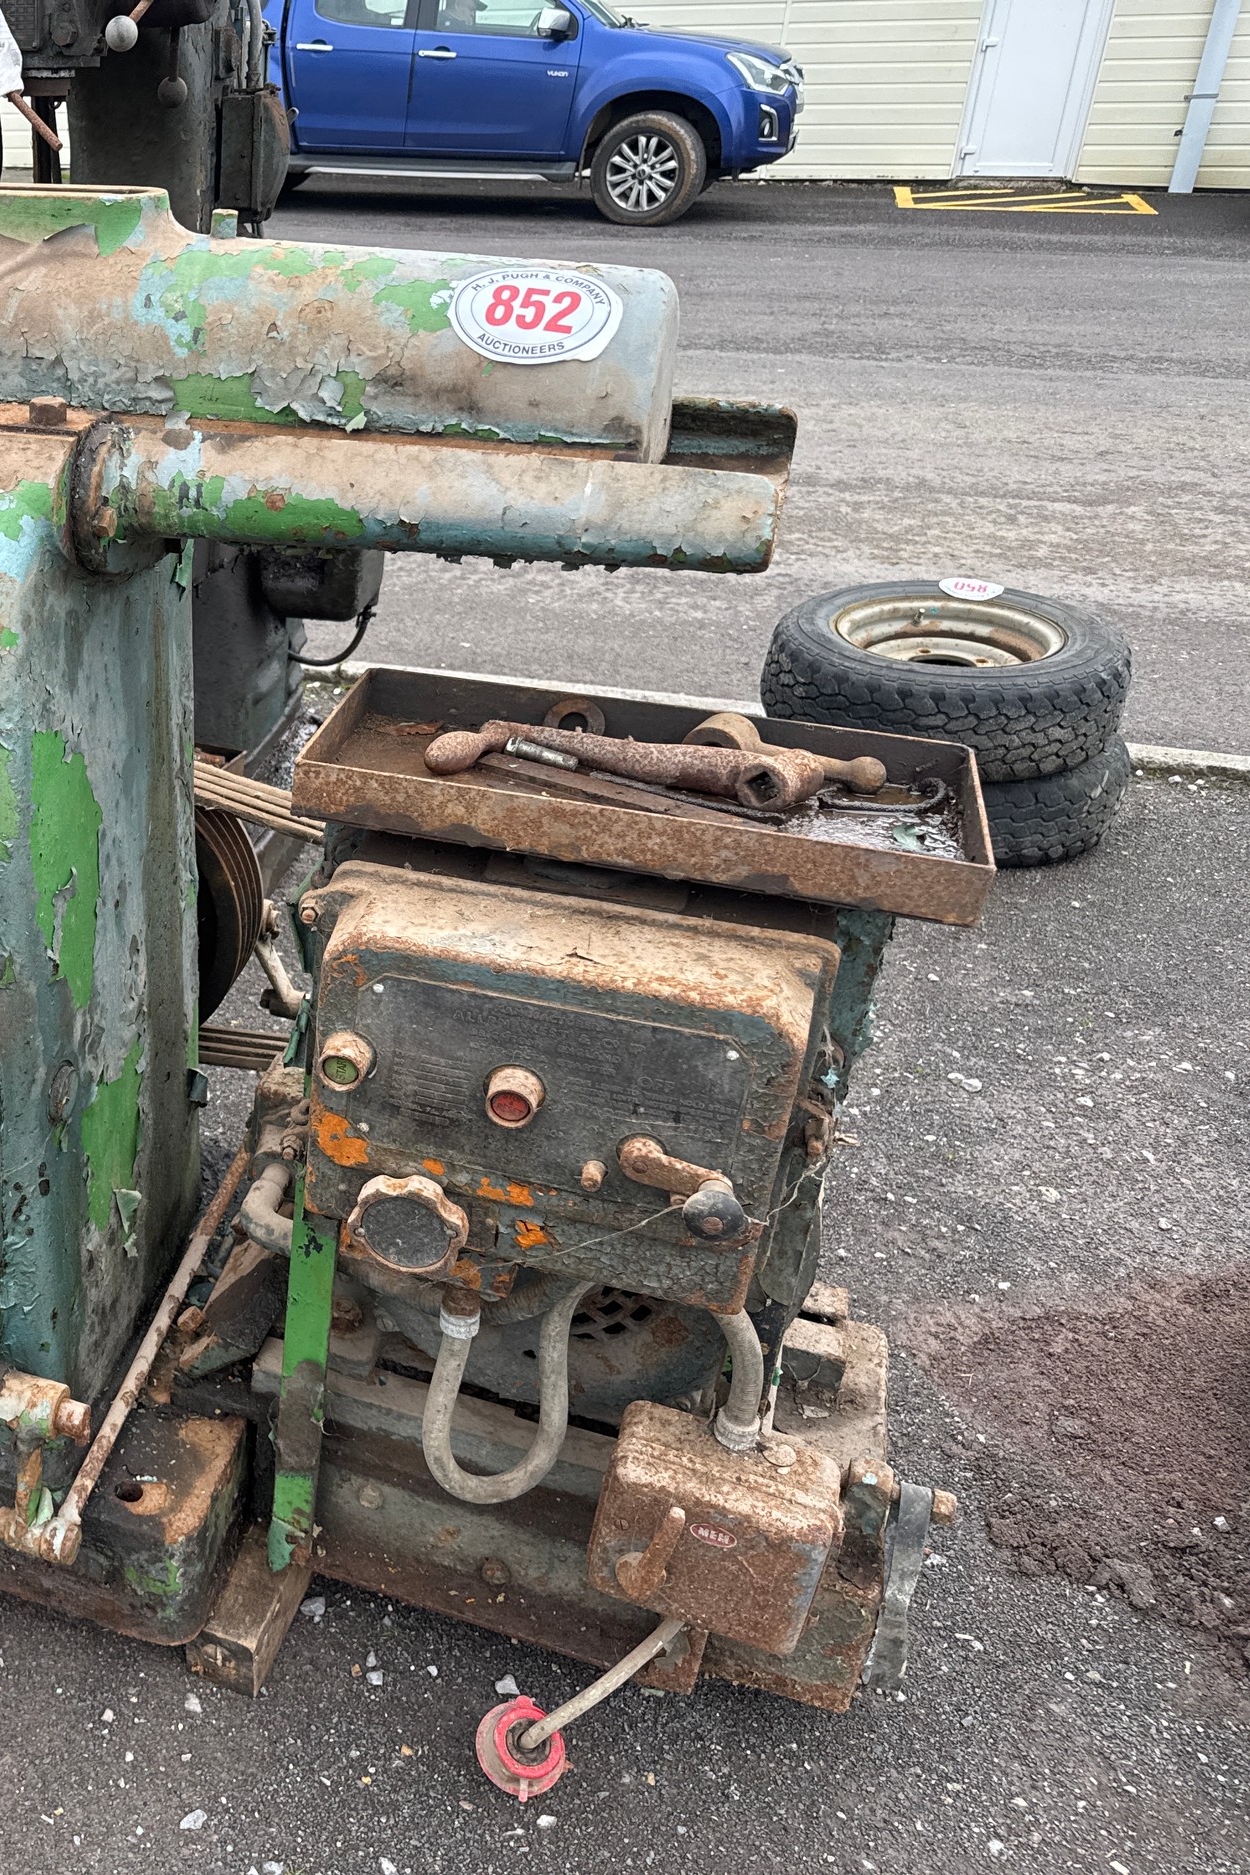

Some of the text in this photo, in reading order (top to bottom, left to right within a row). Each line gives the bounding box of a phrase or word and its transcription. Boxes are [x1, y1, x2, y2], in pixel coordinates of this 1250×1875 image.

[472, 283, 485, 292] H.
[501, 272, 538, 281] PUGH
[556, 275, 606, 305] COMPANY
[484, 284, 582, 335] 852
[477, 332, 565, 354] AUCTIONEERS
[335, 1060, 346, 1080] STAR
[698, 1526, 730, 1544] MEM
